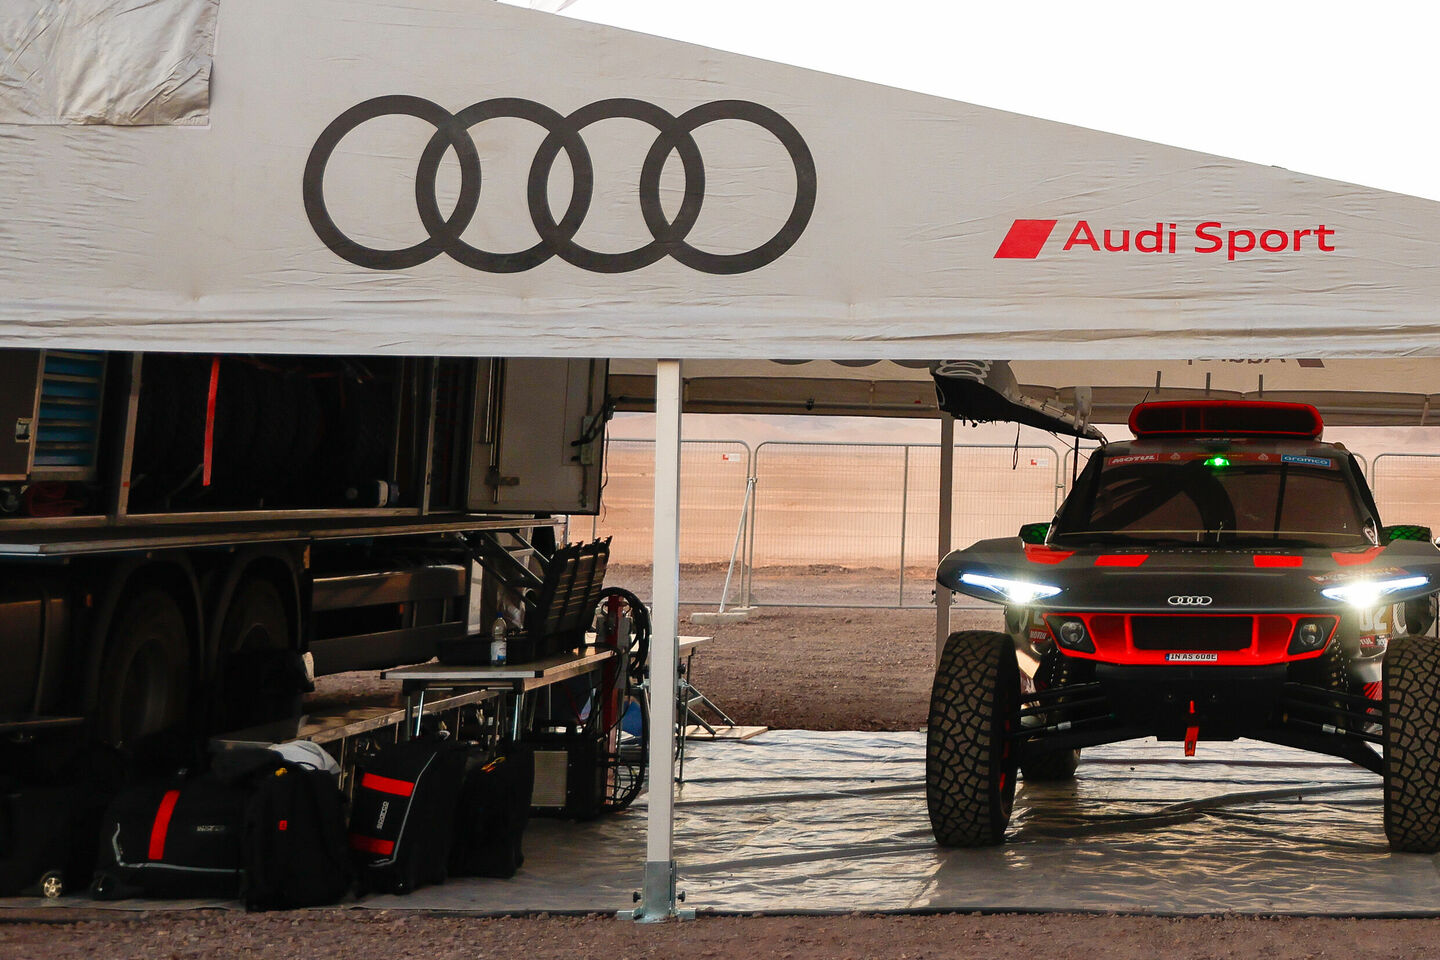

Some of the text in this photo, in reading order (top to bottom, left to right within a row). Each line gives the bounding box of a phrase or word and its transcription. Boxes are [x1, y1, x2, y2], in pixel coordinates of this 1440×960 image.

[1061, 219, 1337, 262] Audi Sport
[1111, 455, 1156, 464] MOTUL
[1284, 456, 1328, 465] aramco
